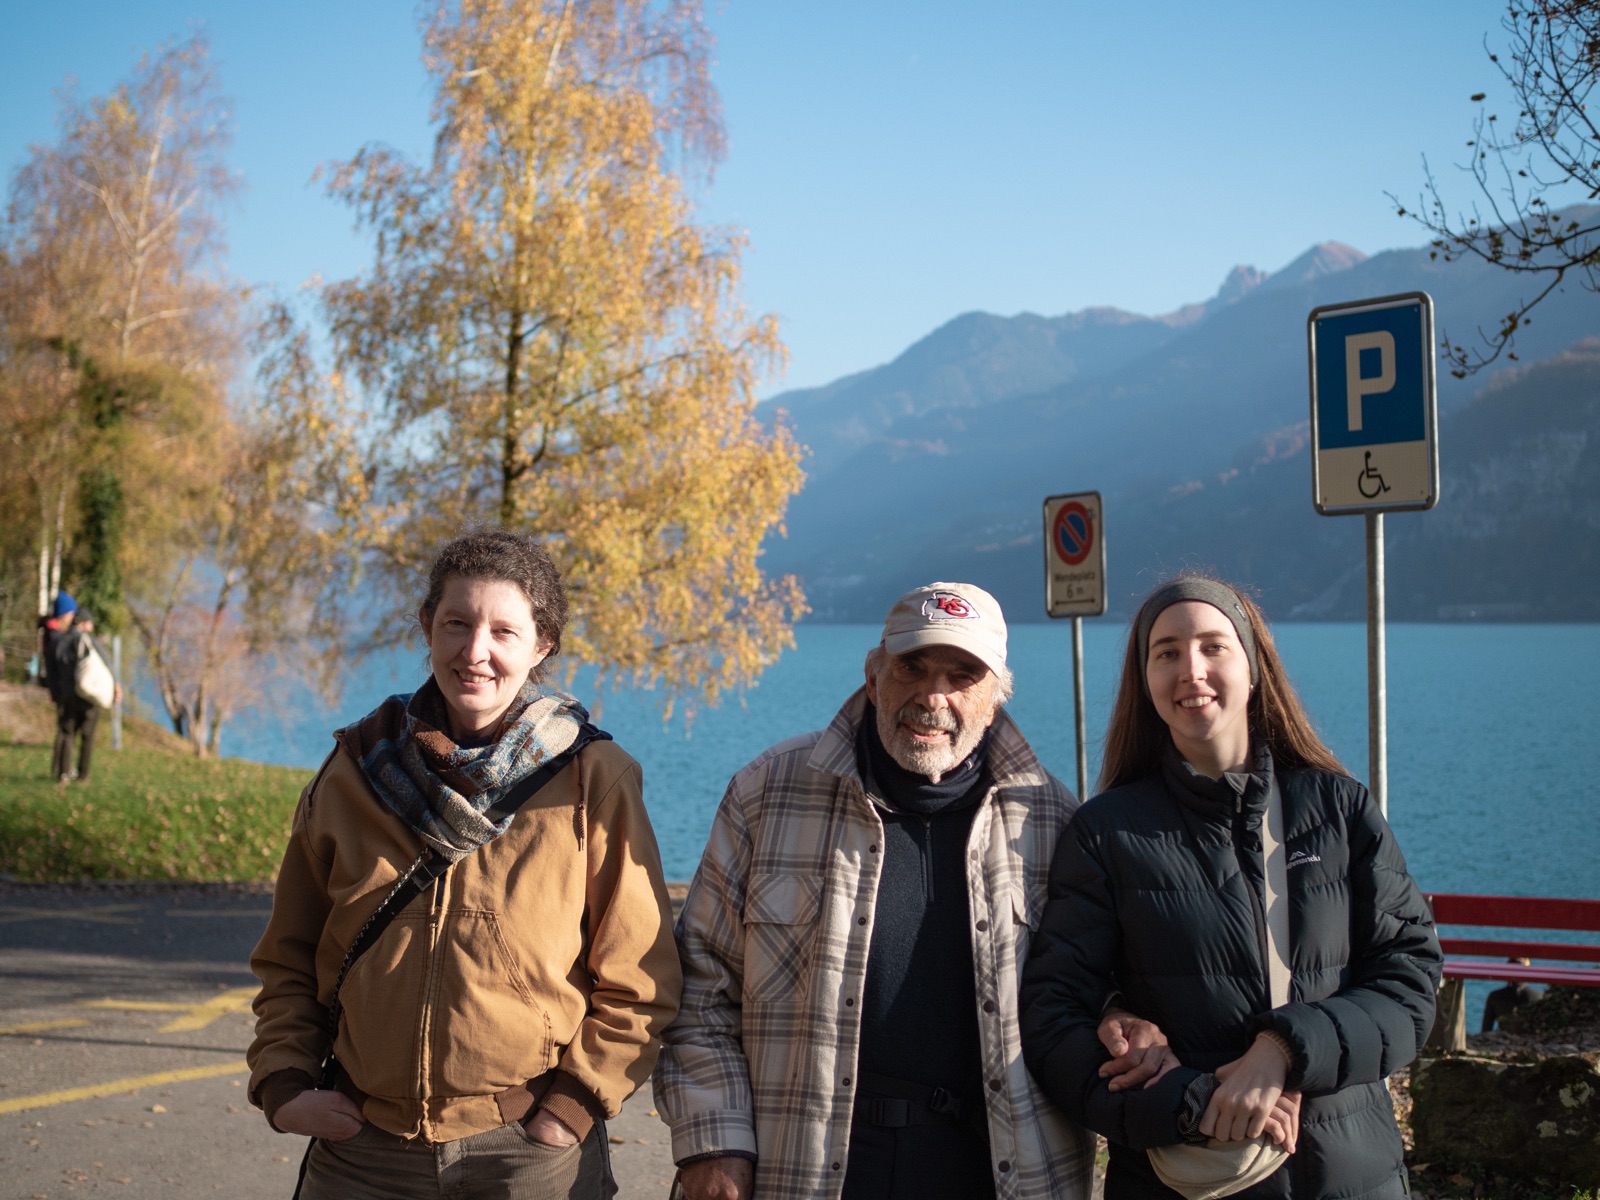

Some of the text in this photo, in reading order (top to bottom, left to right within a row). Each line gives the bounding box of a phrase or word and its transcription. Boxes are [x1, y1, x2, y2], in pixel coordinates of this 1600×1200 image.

[1345, 330, 1397, 432] P
[1066, 583, 1074, 599] 6
[936, 597, 970, 618] KC
